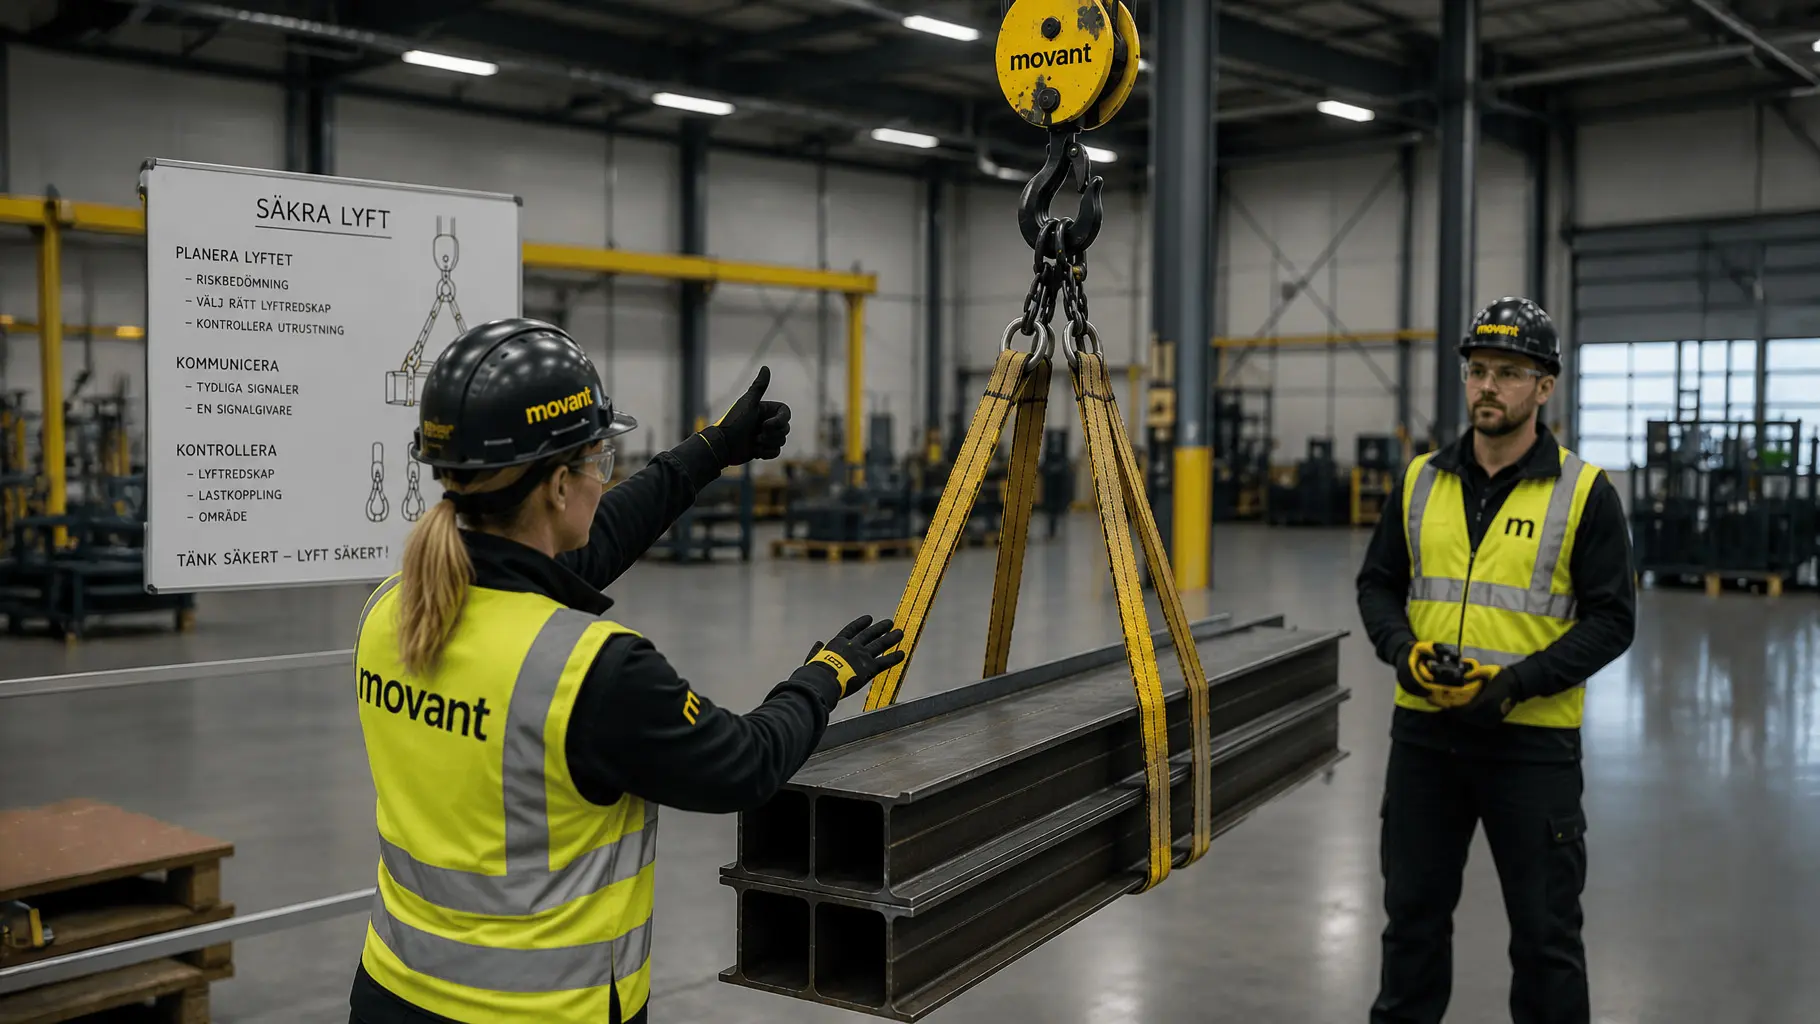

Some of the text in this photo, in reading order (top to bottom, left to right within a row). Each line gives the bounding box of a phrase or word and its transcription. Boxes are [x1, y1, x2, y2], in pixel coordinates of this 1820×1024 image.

[1010, 43, 1092, 71] movant
[257, 195, 390, 229] SÄKRA LYFT
[176, 246, 293, 266] PLANERA LYFTET
[197, 274, 288, 290] RISKBEDÖMNING
[197, 295, 223, 308] VÄLJ
[229, 297, 256, 309] RÄTT
[262, 300, 331, 313] LYFTREDSKAP
[197, 319, 273, 332] KONTROLLERA
[278, 323, 344, 335] UTRUSTNING
[1476, 324, 1520, 337] movant
[177, 357, 279, 372] KOMMUNICERA
[197, 382, 242, 393] TYDLIGA
[248, 384, 299, 394] SIGNALER
[197, 404, 211, 414] EN
[217, 404, 292, 415] SIGNALGIVARE
[525, 386, 594, 425] movant
[177, 444, 277, 456] KONTROLLERA
[199, 469, 274, 479] LYFTREDSKAP
[199, 489, 282, 500] LASTKOPPLING
[1504, 518, 1535, 539] m
[177, 550, 217, 567] TÄNK
[224, 549, 278, 565] SÄKERT
[298, 549, 328, 562] LYFT
[335, 545, 388, 560] SÄKERT!
[359, 667, 491, 742] movant
